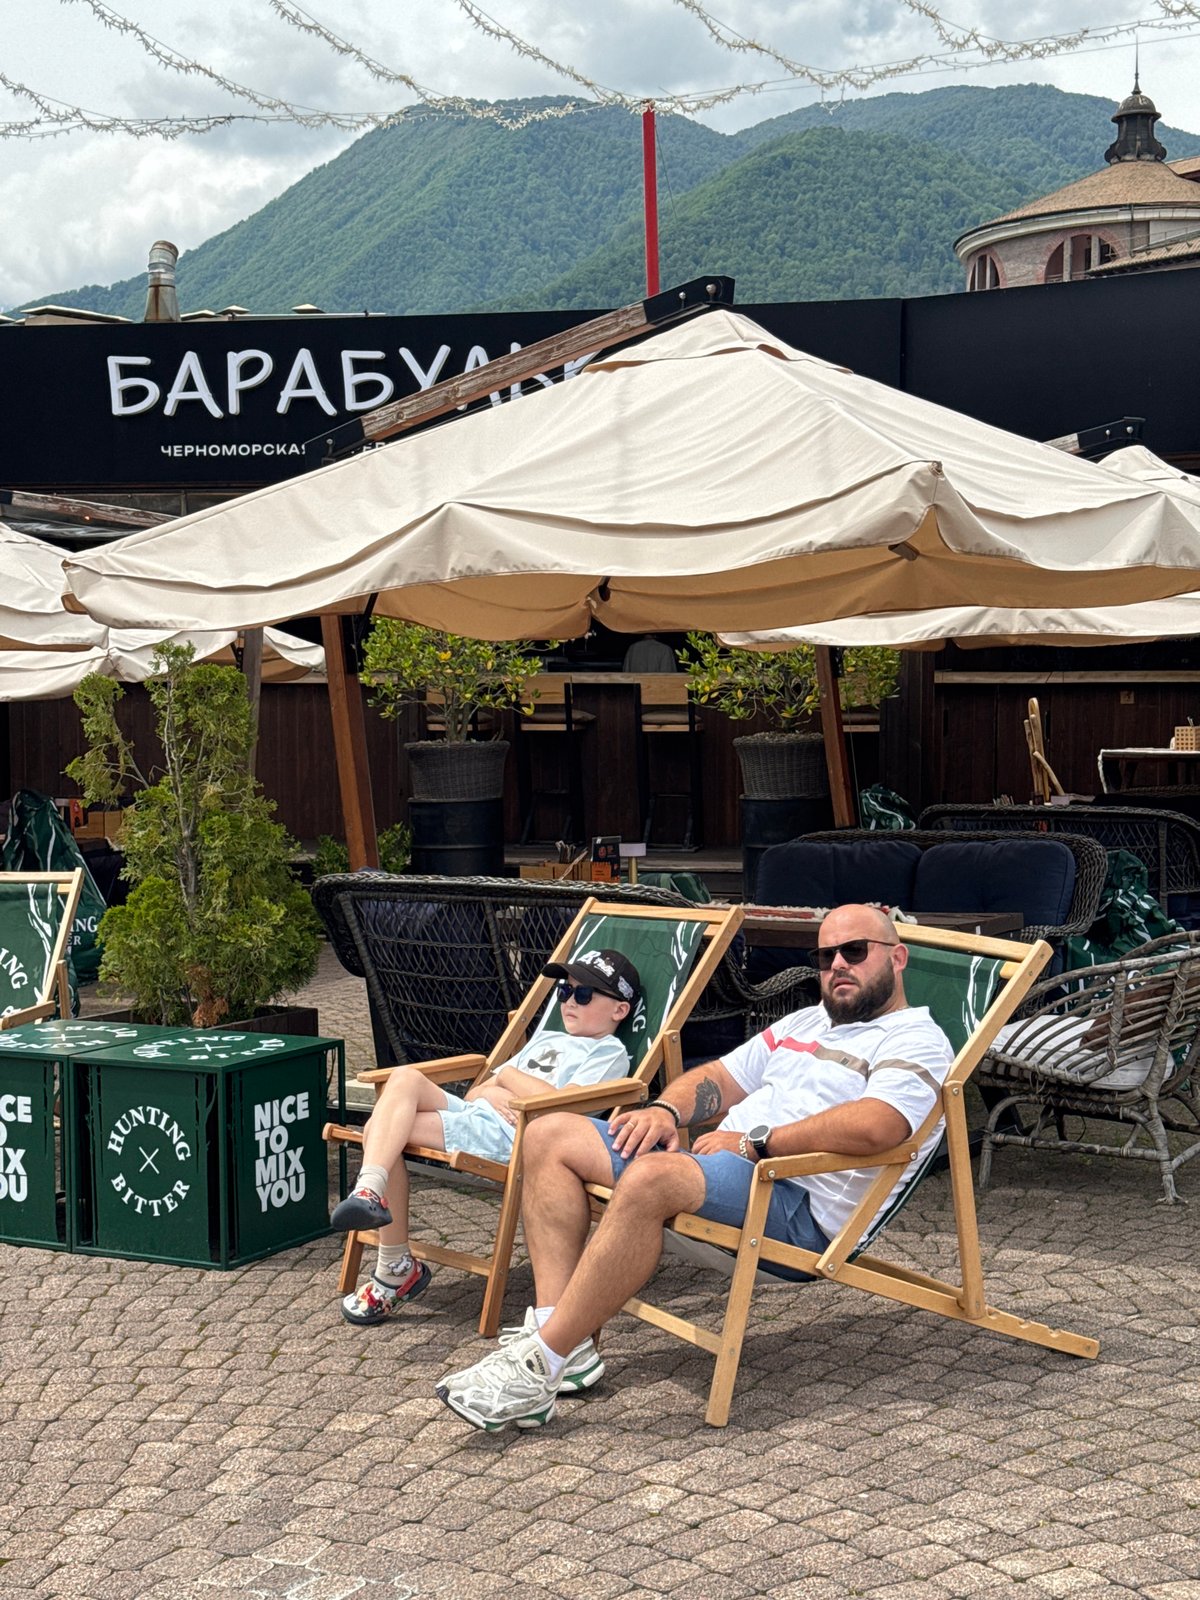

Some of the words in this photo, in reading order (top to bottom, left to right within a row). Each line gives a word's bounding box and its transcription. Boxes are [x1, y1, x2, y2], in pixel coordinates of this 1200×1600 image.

[0, 1094, 33, 1123] CE
[254, 1091, 310, 1132] NICE
[107, 1105, 191, 1161] HUNTING
[254, 1125, 289, 1158] TO
[255, 1146, 306, 1187] MIX
[0, 1173, 28, 1202] OU
[111, 1173, 190, 1217] BITTER
[256, 1172, 306, 1213] YOU
